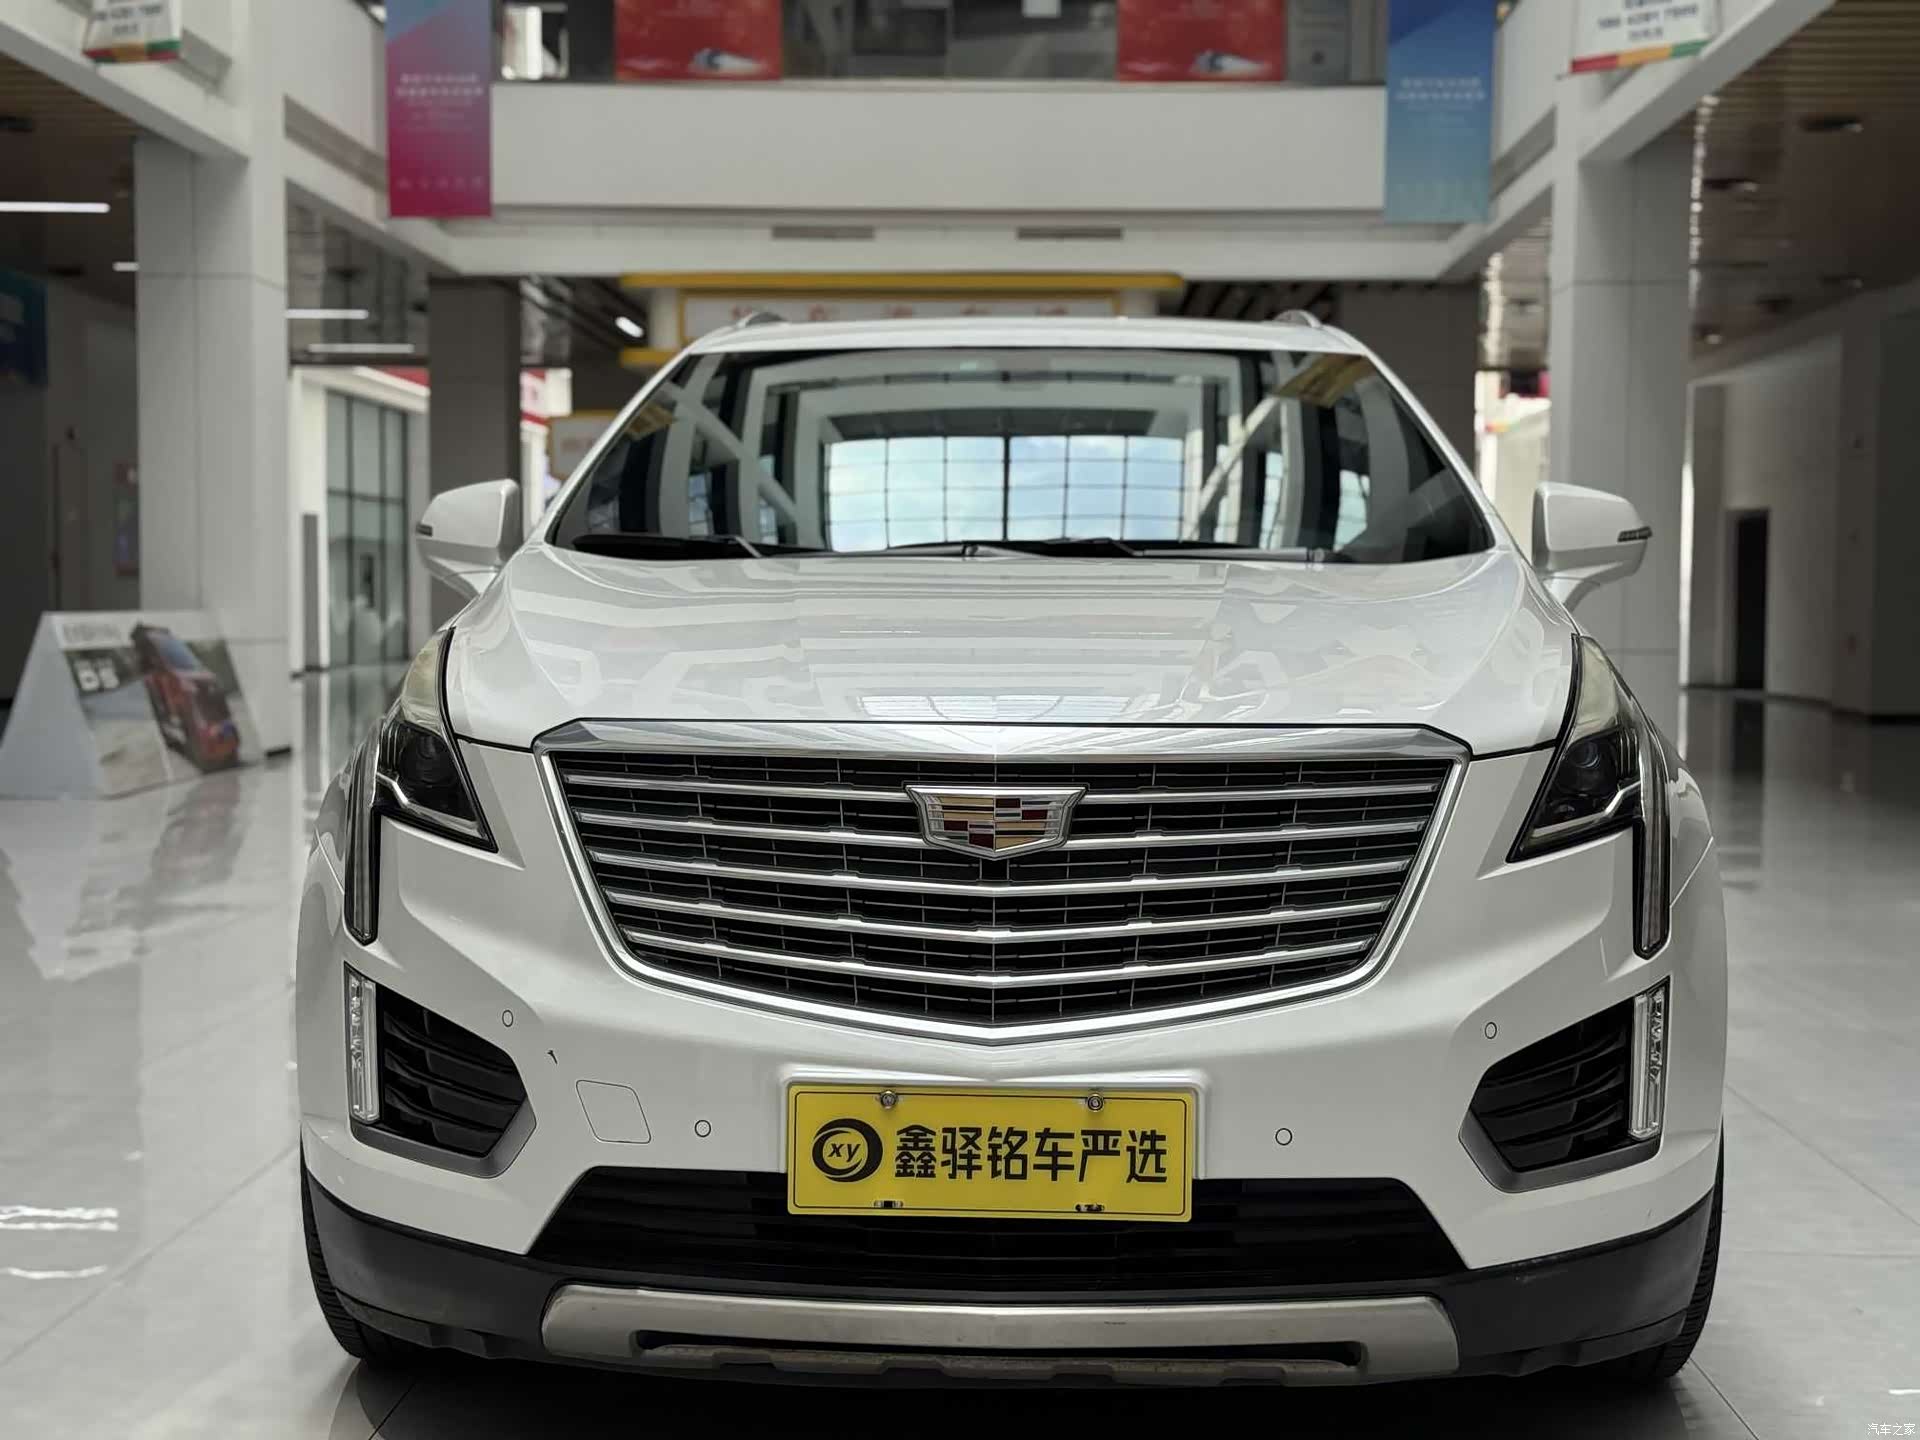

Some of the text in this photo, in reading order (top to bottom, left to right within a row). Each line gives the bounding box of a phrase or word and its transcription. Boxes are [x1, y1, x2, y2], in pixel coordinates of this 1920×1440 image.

[894, 1124, 1168, 1183] 鑫驿铭车严选
